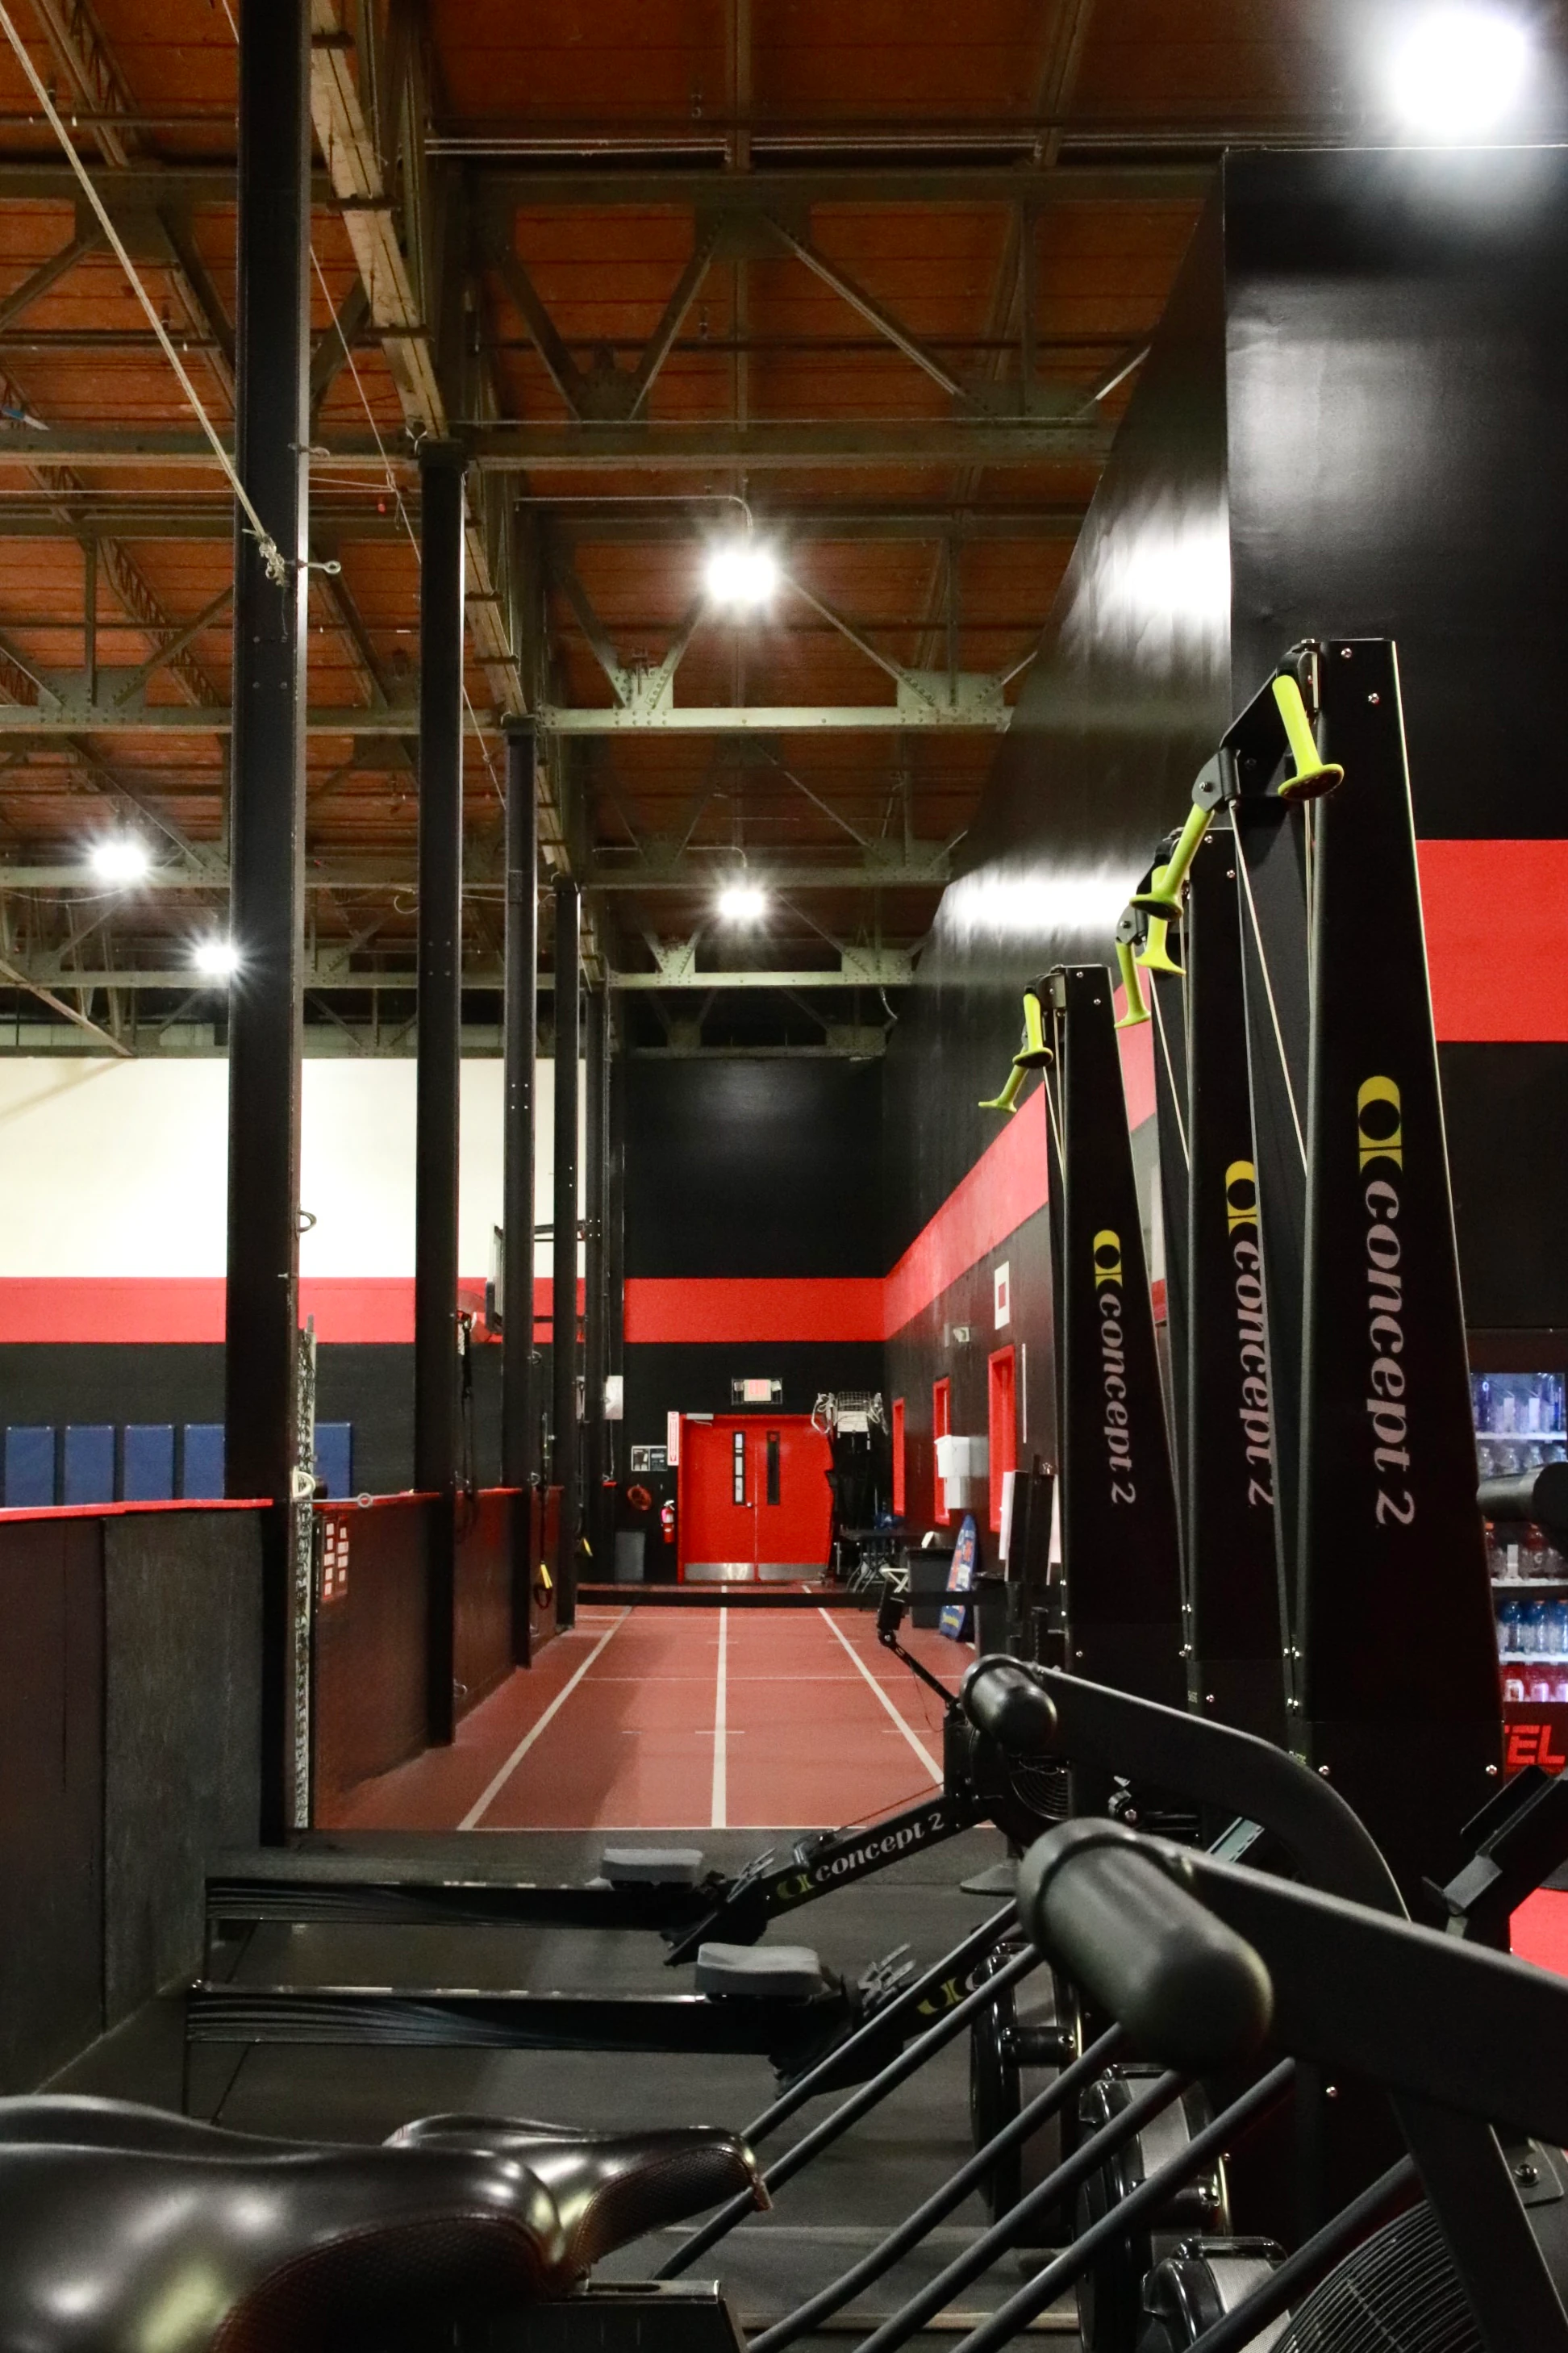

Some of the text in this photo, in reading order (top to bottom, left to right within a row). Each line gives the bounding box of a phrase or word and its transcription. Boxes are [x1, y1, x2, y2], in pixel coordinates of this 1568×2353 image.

[1099, 1293, 1136, 1504] concept 2
[1232, 1240, 1272, 1465] concept
[1365, 1179, 1415, 1526] concept 2
[815, 1812, 945, 1883] concept 2
